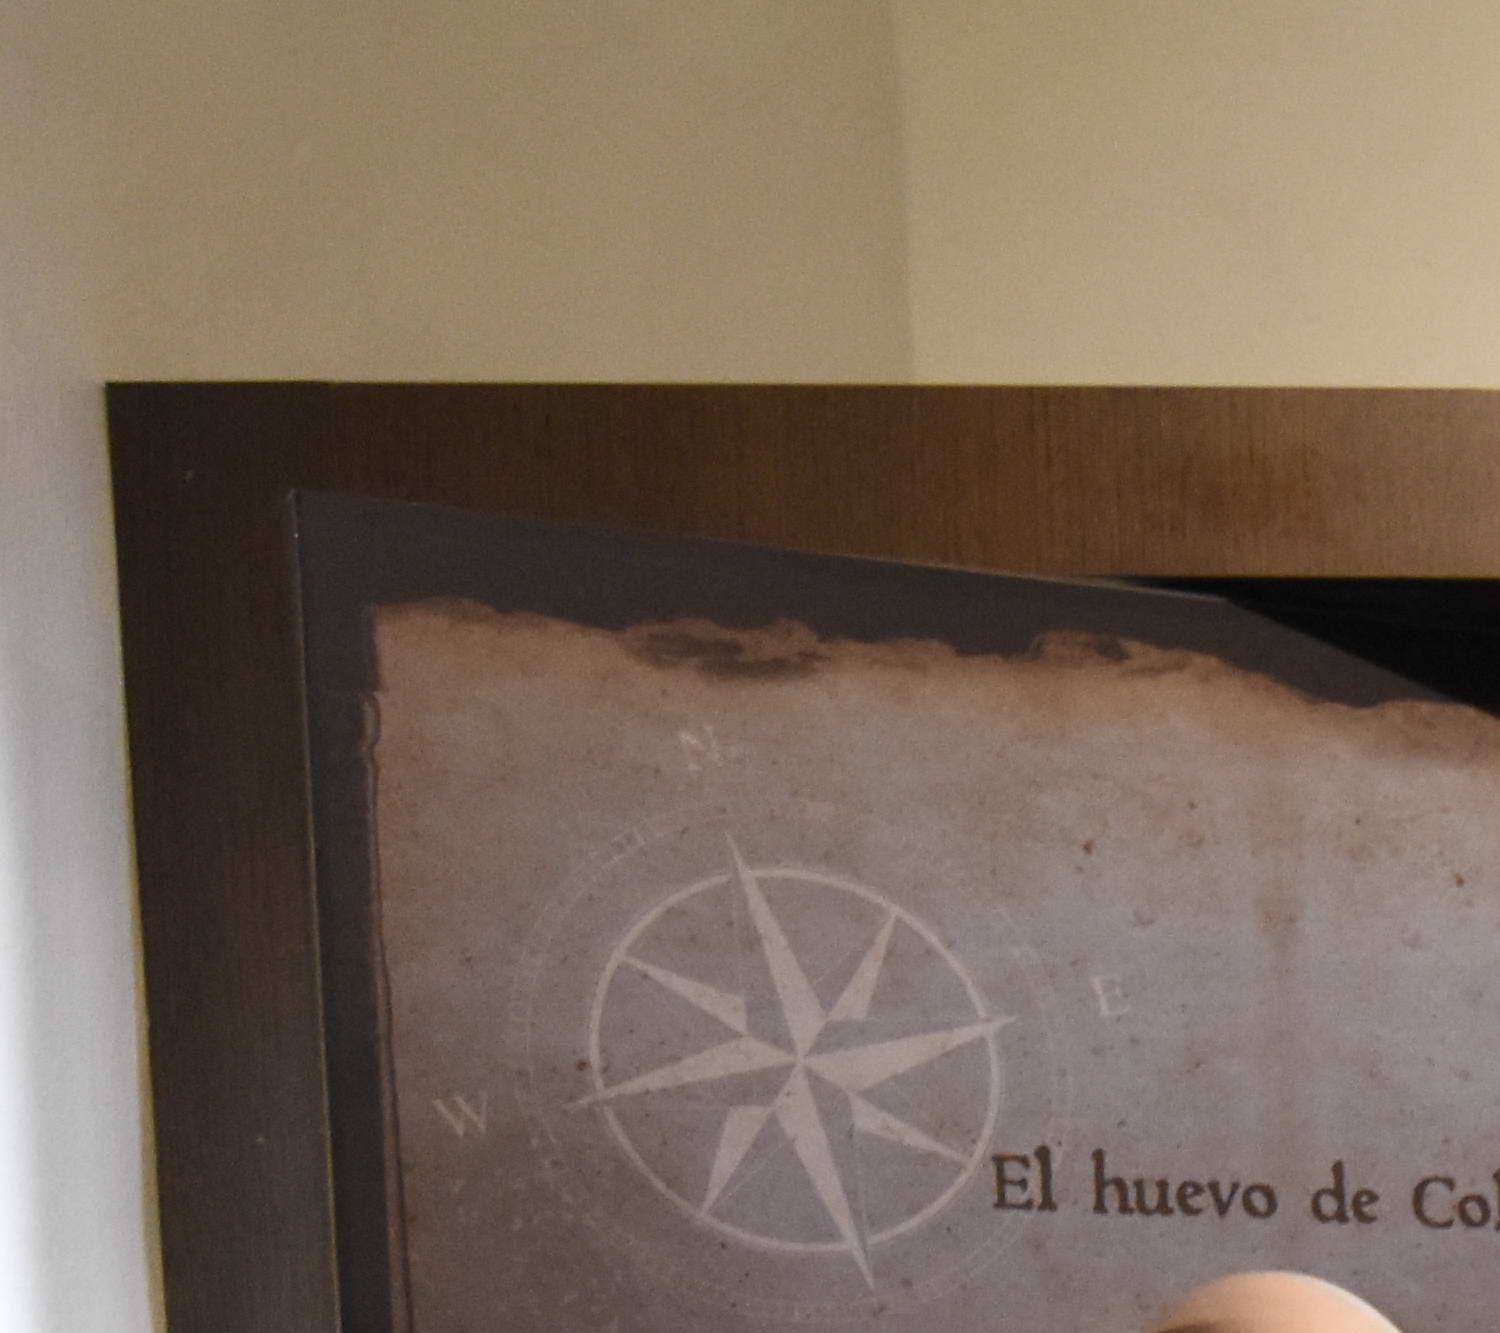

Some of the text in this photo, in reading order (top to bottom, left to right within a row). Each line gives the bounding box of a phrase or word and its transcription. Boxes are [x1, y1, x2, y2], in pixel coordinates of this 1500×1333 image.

[1088, 974, 1132, 1018] E
[430, 1088, 488, 1138] W
[991, 1143, 1059, 1214] El
[1091, 1146, 1279, 1220] huevo
[1309, 1158, 1381, 1225] de
